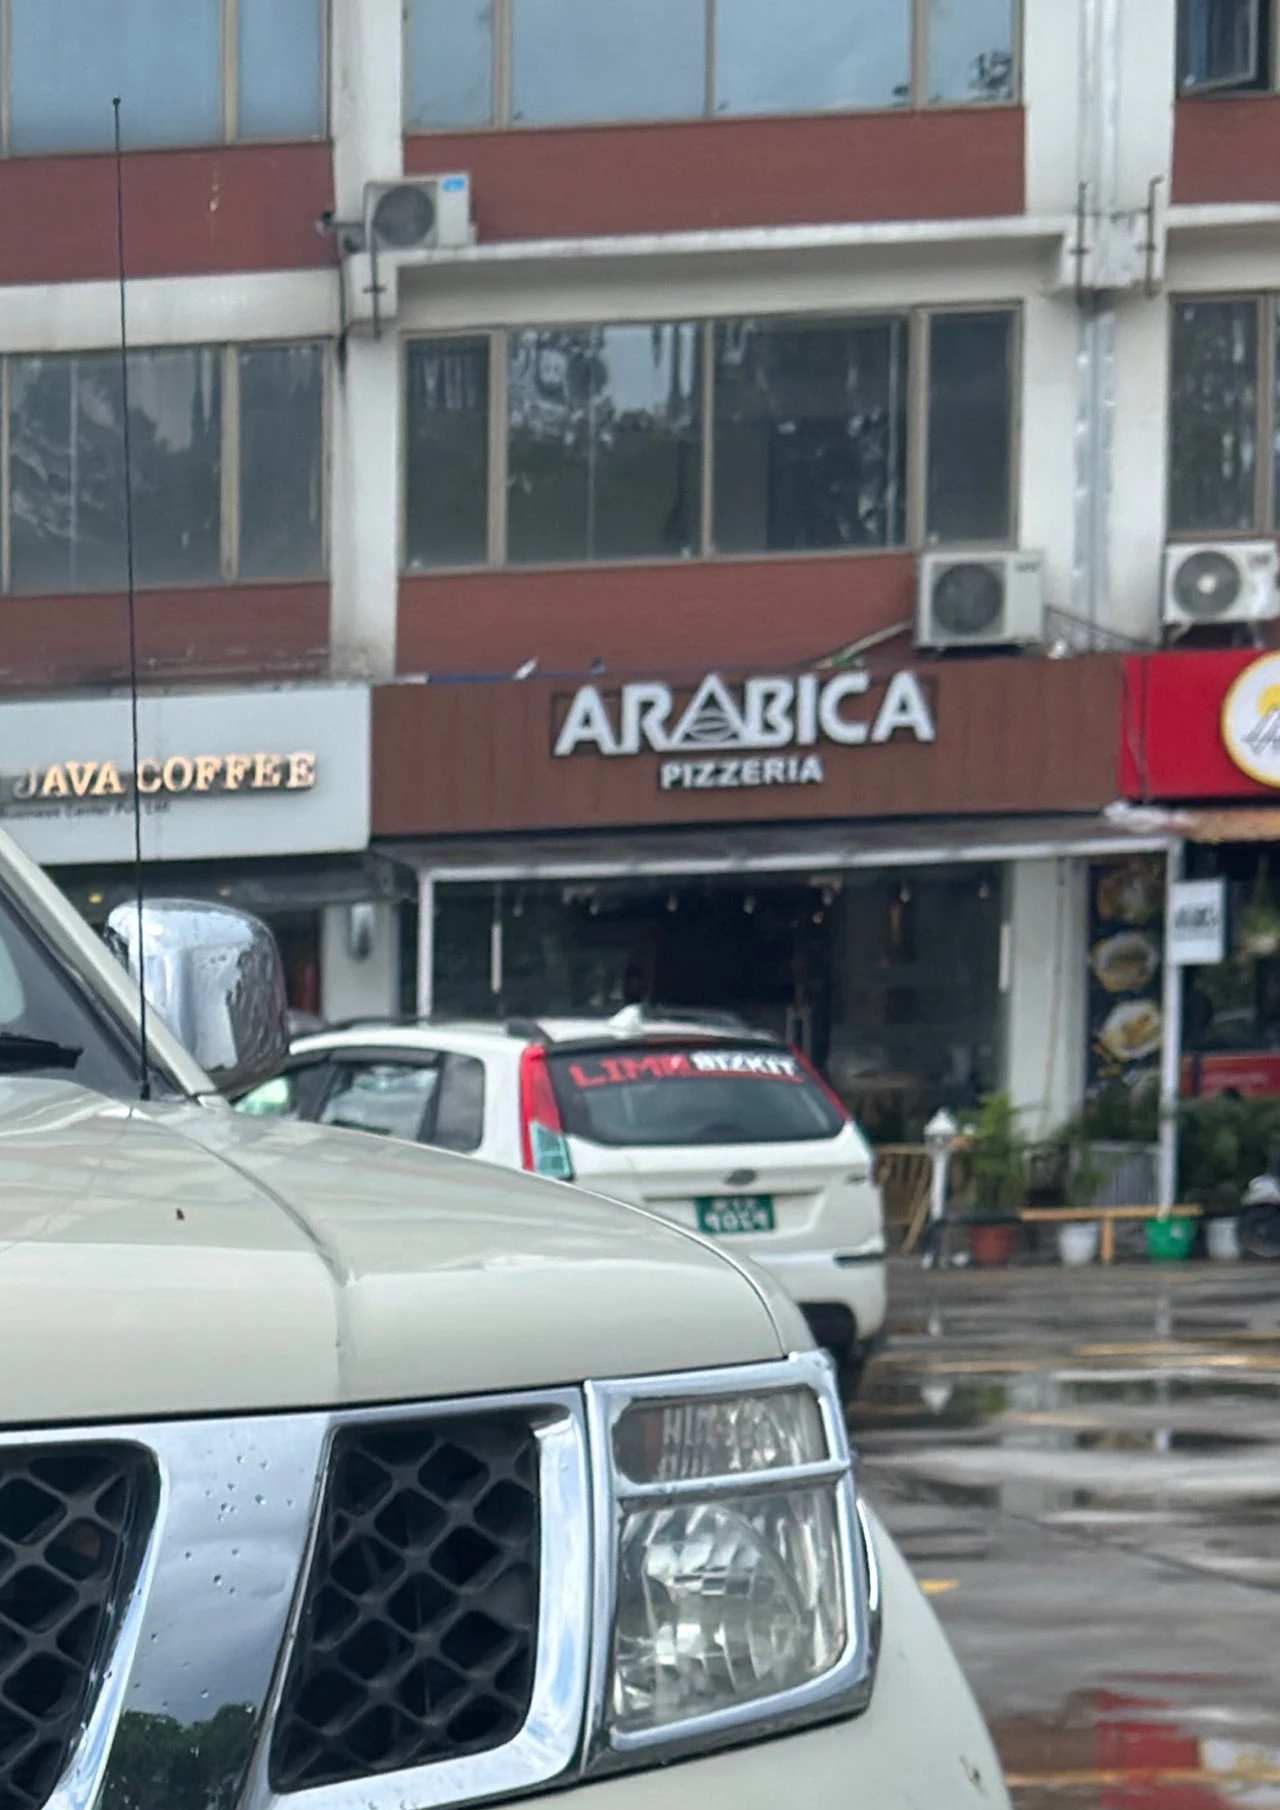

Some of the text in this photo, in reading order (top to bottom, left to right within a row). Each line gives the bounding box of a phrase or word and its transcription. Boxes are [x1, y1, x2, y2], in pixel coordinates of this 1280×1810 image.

[552, 670, 936, 756] ARABICA
[12, 761, 125, 799] JAVA
[137, 752, 315, 793] COFFEE
[660, 755, 825, 790] PIZZERIA
